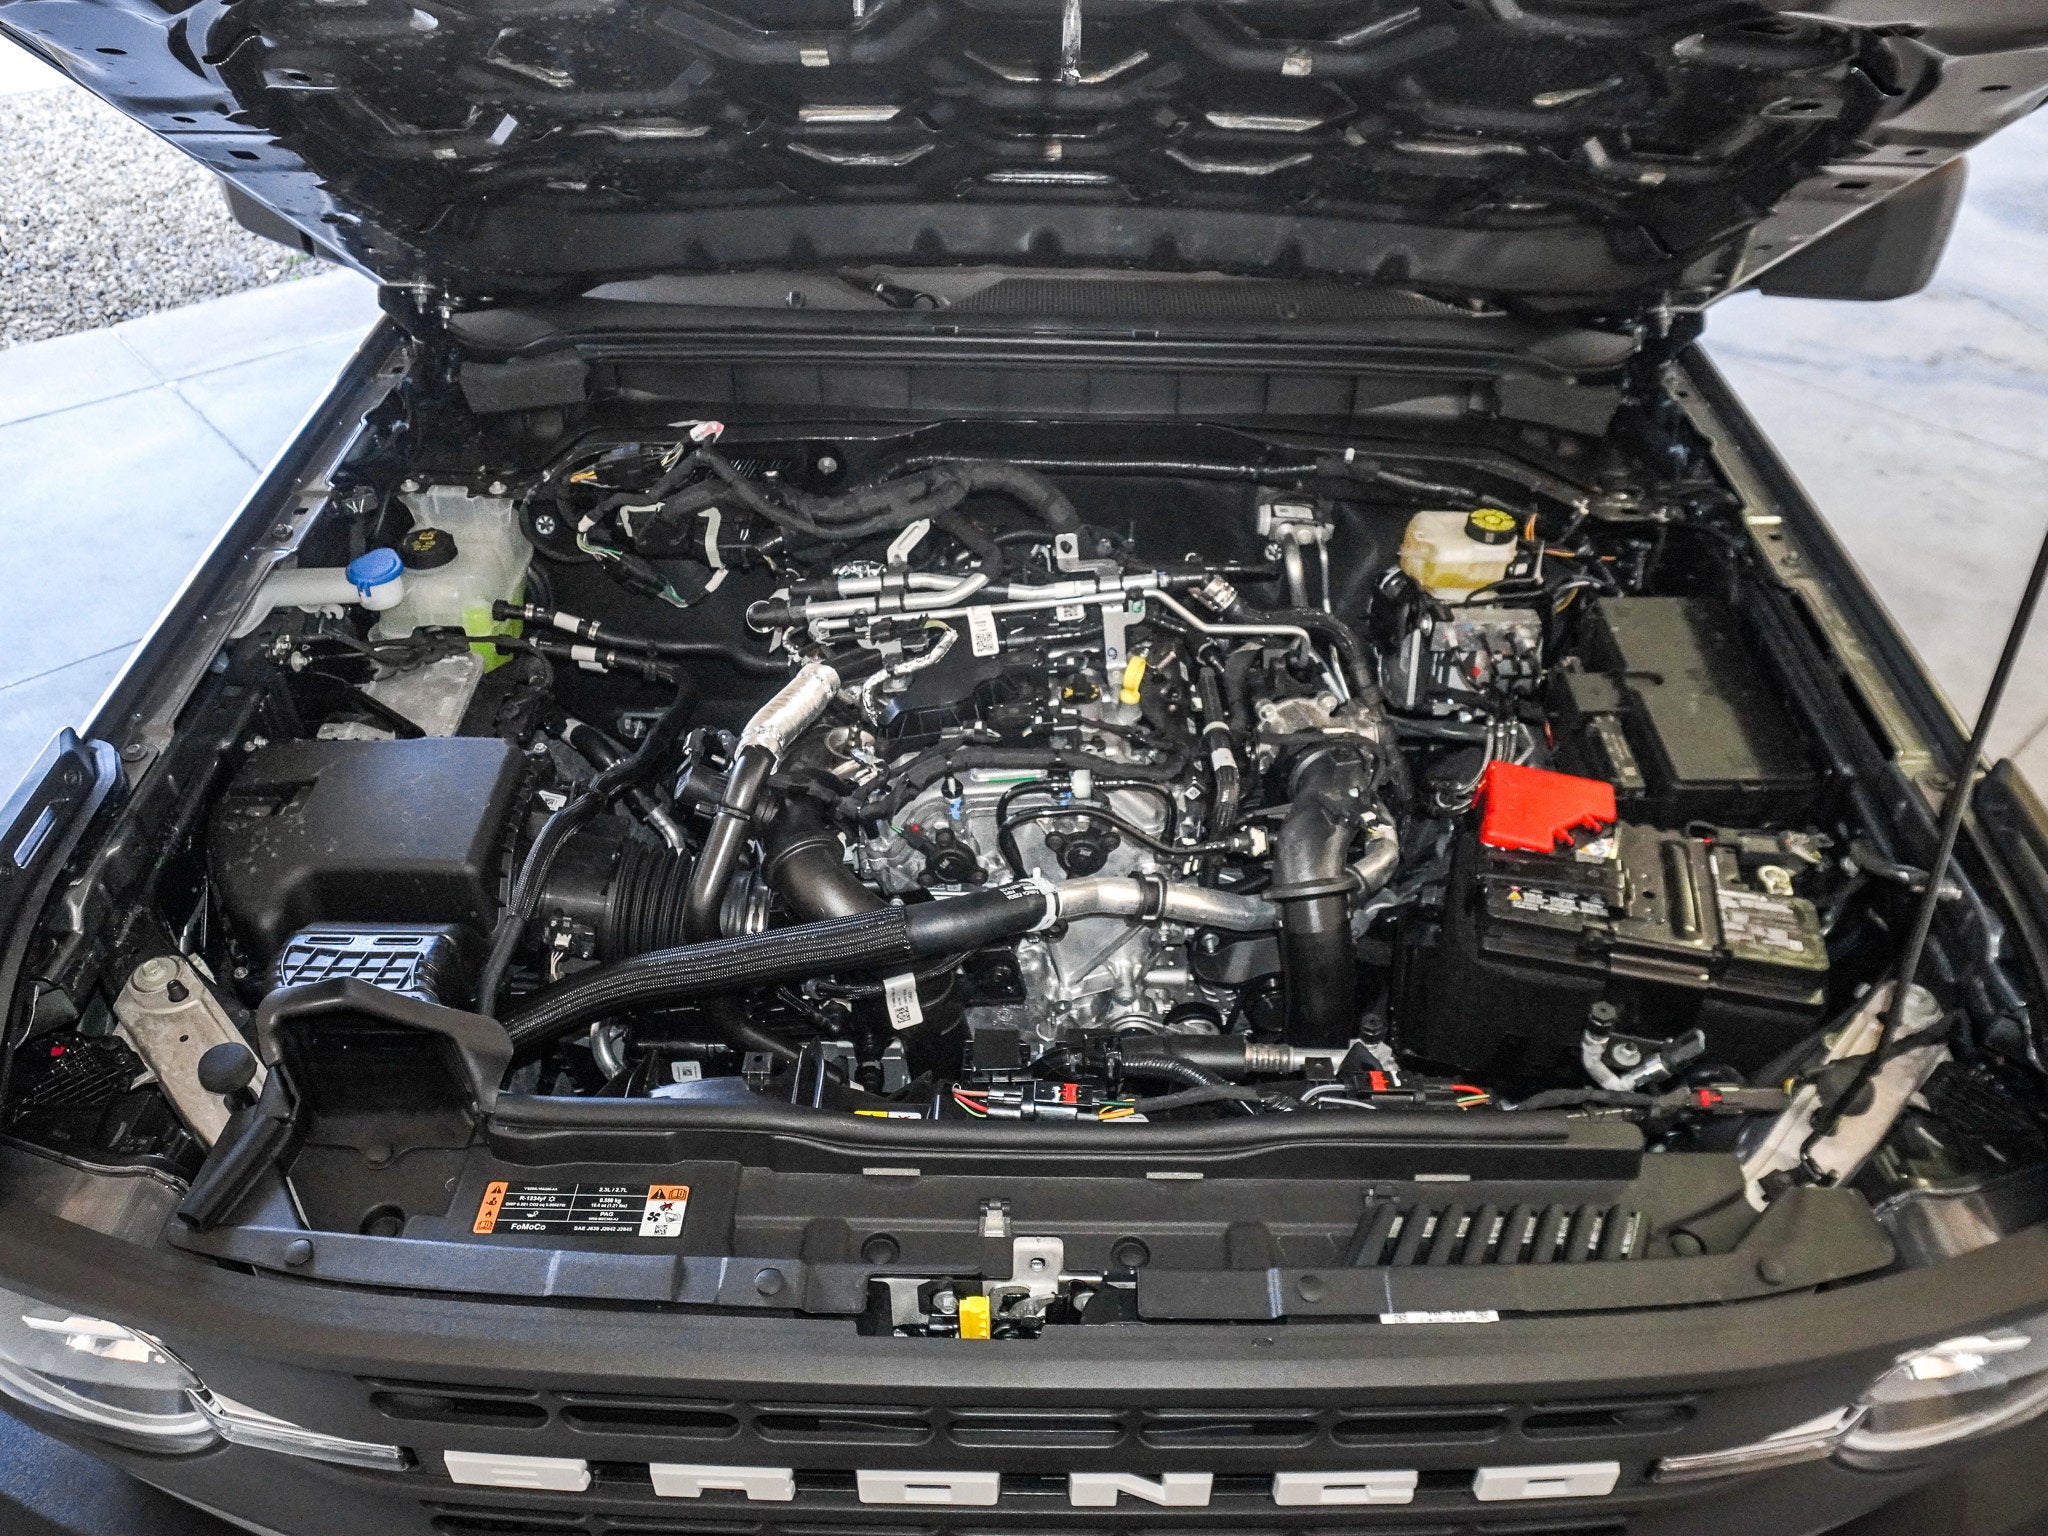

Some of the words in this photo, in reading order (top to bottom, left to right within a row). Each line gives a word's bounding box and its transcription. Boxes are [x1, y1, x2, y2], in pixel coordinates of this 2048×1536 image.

[519, 1195, 547, 1203] R-1234yf
[510, 1222, 546, 1231] FoMoCo
[443, 1449, 1621, 1507] BRONCO
